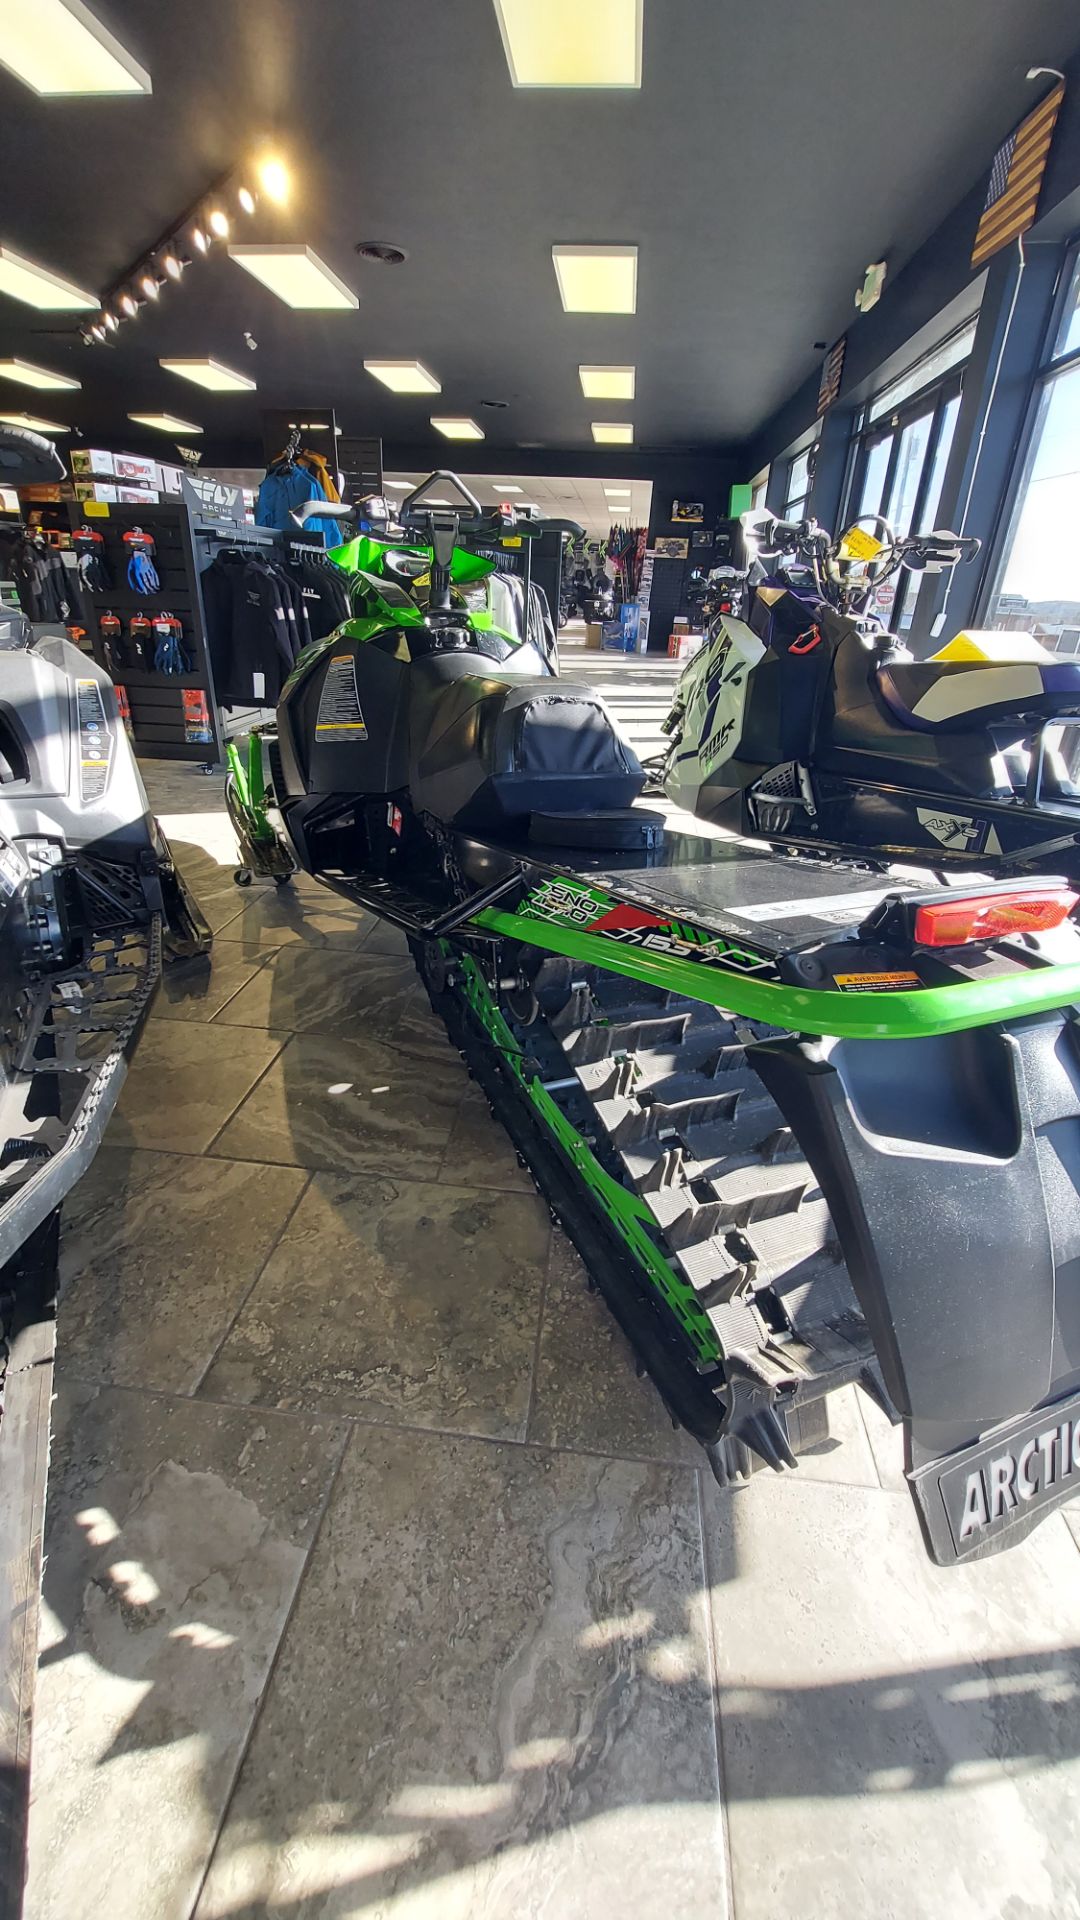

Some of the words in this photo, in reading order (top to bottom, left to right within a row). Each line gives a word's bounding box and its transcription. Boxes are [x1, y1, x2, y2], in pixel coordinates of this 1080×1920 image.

[186, 476, 239, 507] FLY
[699, 718, 735, 762] RMK
[546, 882, 599, 914] SNO
